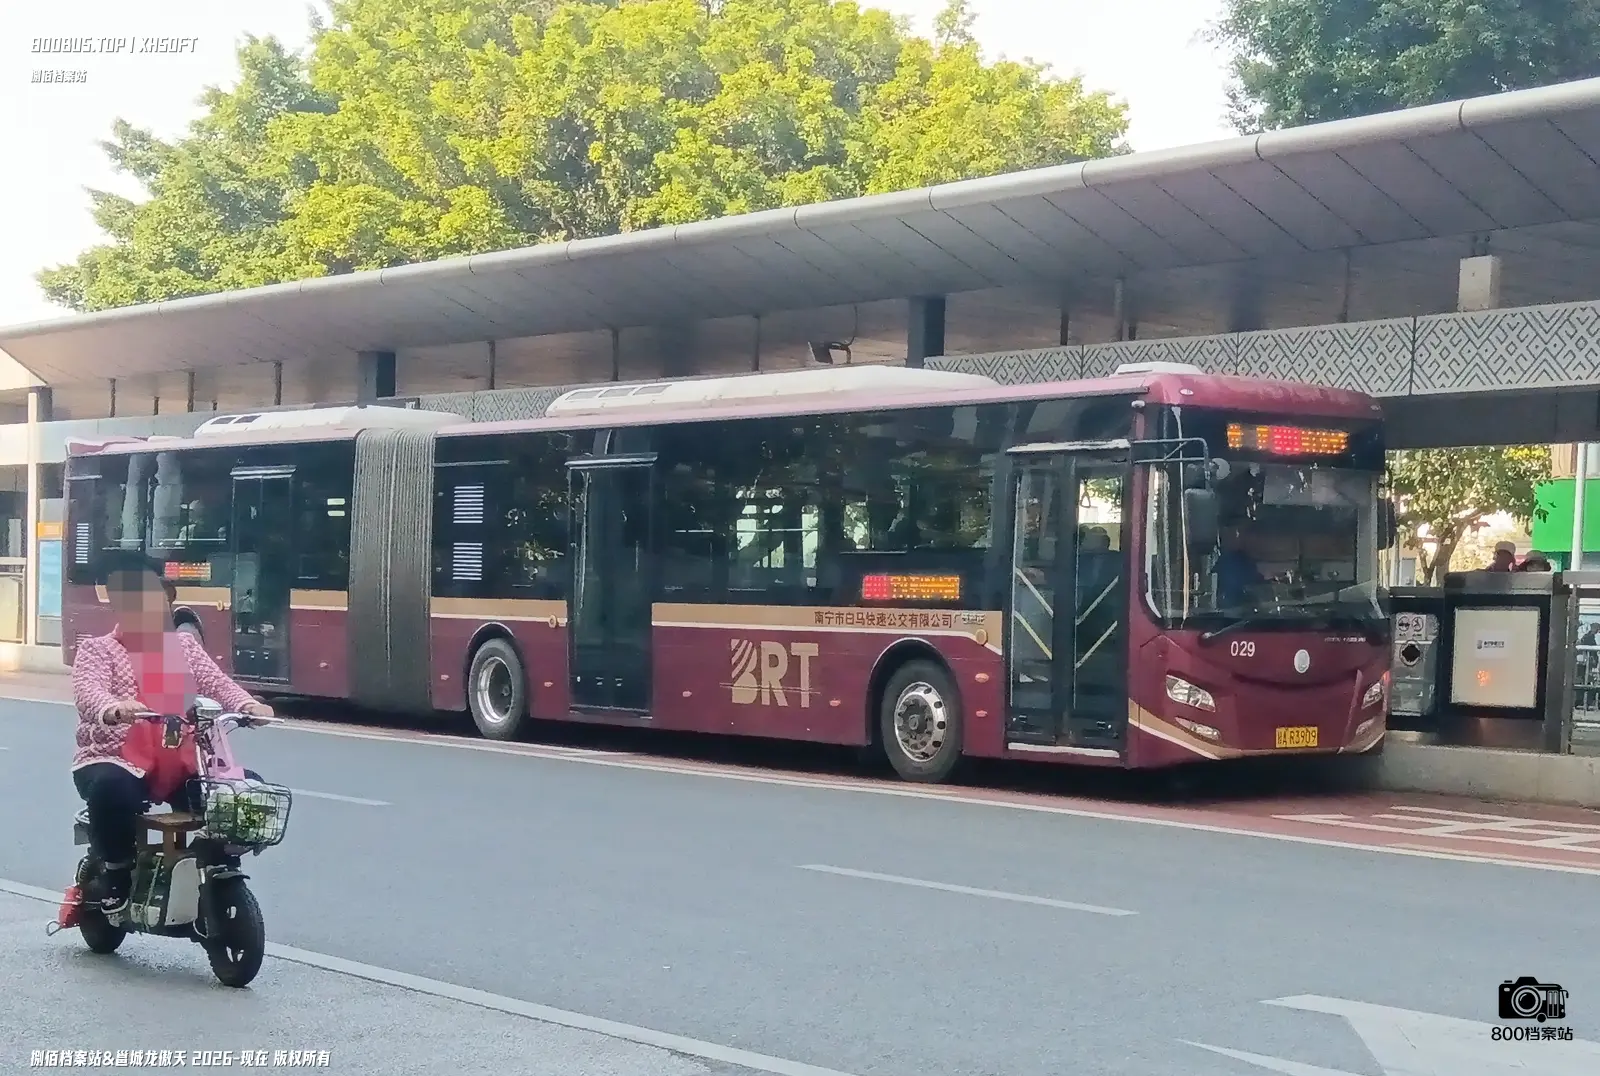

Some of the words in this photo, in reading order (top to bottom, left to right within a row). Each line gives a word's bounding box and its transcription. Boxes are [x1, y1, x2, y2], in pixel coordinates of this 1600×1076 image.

[814, 610, 952, 628] 南宁市白马快速公交有限公司
[1230, 641, 1256, 657] 029
[730, 638, 819, 708] BRT
